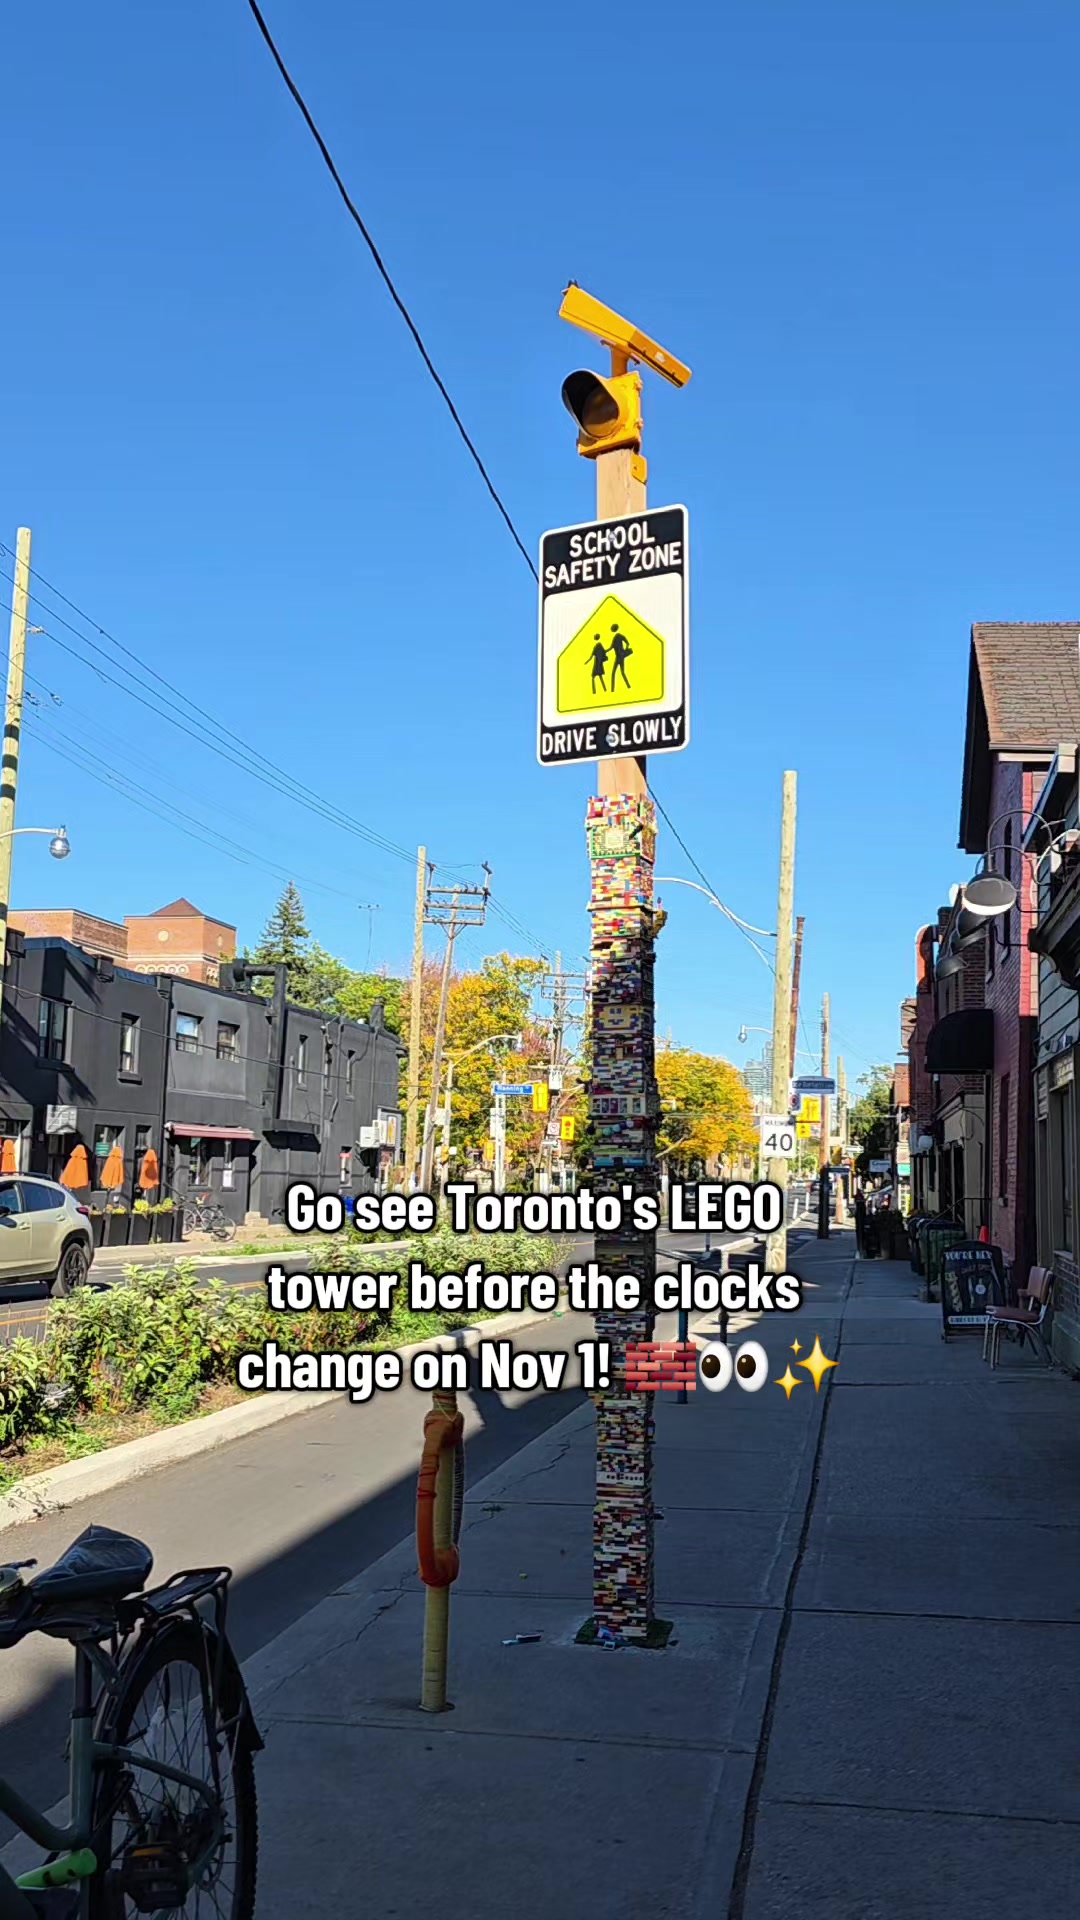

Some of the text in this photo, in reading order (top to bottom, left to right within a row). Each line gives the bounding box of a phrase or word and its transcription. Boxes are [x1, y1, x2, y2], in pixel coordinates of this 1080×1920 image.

[569, 521, 655, 557] SCHOOL
[544, 541, 682, 588] SAFETY ZONE
[542, 716, 683, 756] DRIVE SLOWLY
[765, 1133, 793, 1151] 40
